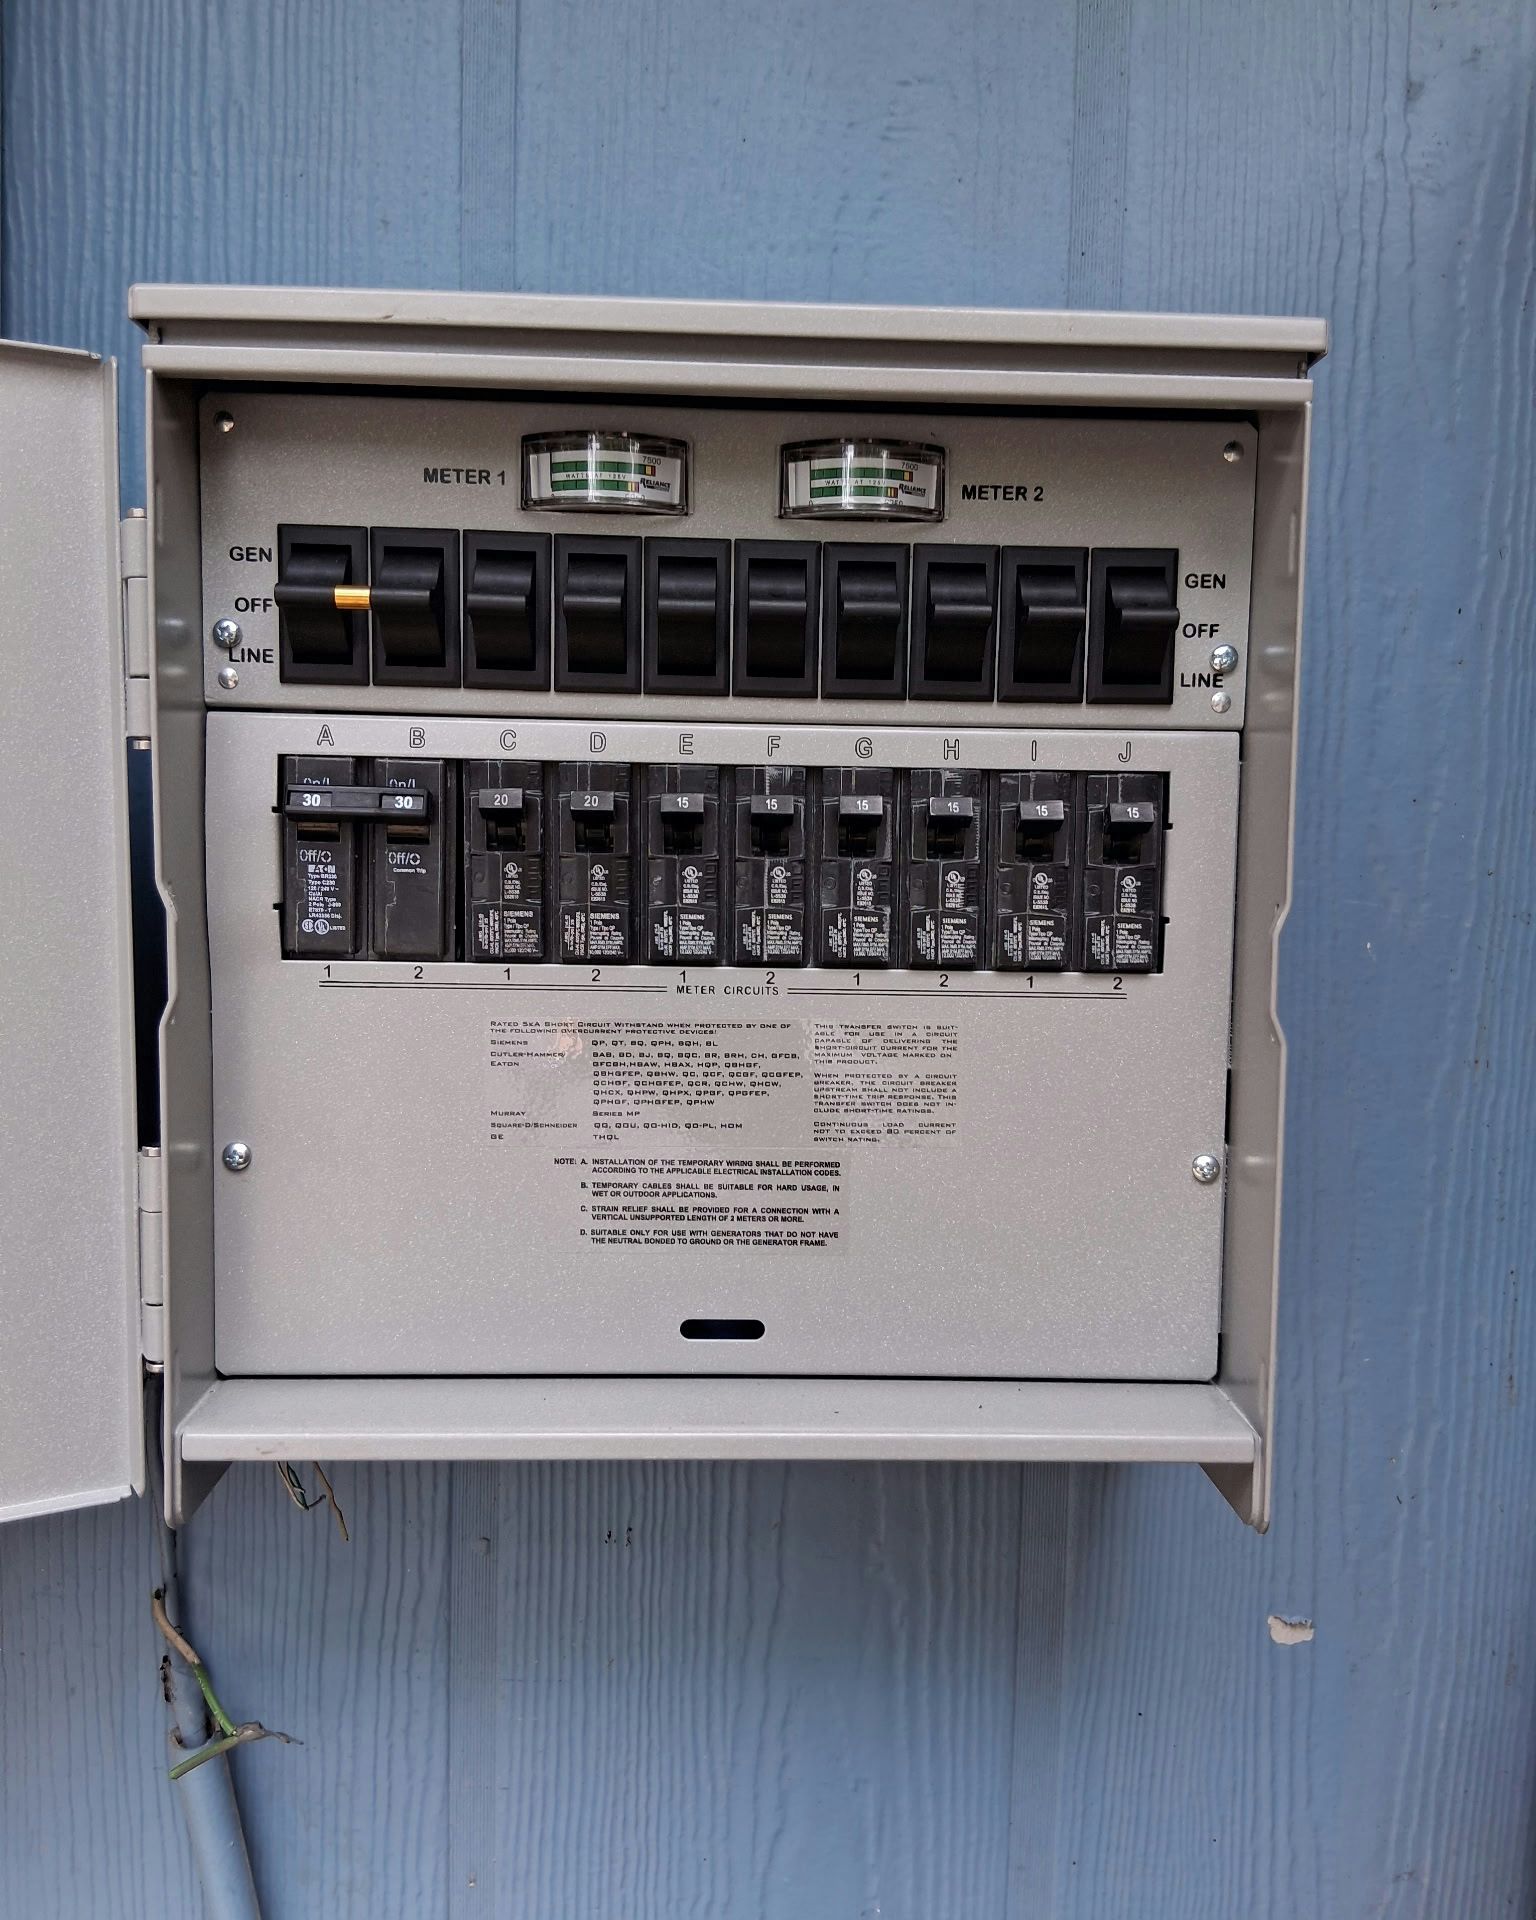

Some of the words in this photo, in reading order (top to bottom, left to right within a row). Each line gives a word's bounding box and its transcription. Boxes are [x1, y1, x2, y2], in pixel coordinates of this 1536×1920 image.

[424, 468, 490, 484] METER
[497, 470, 505, 485] 1
[962, 485, 1027, 501] METER
[1034, 486, 1043, 501] 2
[230, 546, 272, 562] GEN
[1185, 574, 1226, 589] GEN
[234, 597, 273, 613] OFF
[1182, 623, 1220, 638] OFF
[228, 648, 274, 664] LINE
[1180, 672, 1224, 688] LINE
[317, 725, 334, 746] A
[410, 727, 426, 748] B
[500, 730, 517, 750] C
[590, 732, 606, 752] D
[679, 734, 693, 754] E
[768, 736, 780, 756] F
[855, 737, 873, 759] G
[944, 739, 960, 760] H
[1032, 740, 1037, 761] I
[1118, 741, 1132, 762] J
[302, 793, 321, 807] 30
[395, 795, 412, 809] 30
[494, 794, 508, 806] 20
[584, 796, 599, 807] 20
[677, 797, 689, 809] 15
[765, 799, 777, 810] 15
[856, 800, 868, 811] 15
[947, 801, 959, 814] 15
[1036, 805, 1048, 817] 15
[1127, 807, 1139, 819] 15
[324, 965, 331, 978] 1
[414, 966, 423, 979] 2
[504, 968, 511, 980] 1
[591, 969, 600, 982] 2
[679, 970, 686, 983] 1
[766, 972, 775, 984] 2
[853, 974, 860, 986] 1
[940, 975, 949, 987] 2
[1026, 976, 1033, 988] 1
[1113, 978, 1123, 990] 2
[676, 984, 715, 994] METER
[723, 985, 778, 995] CIRCUITS
